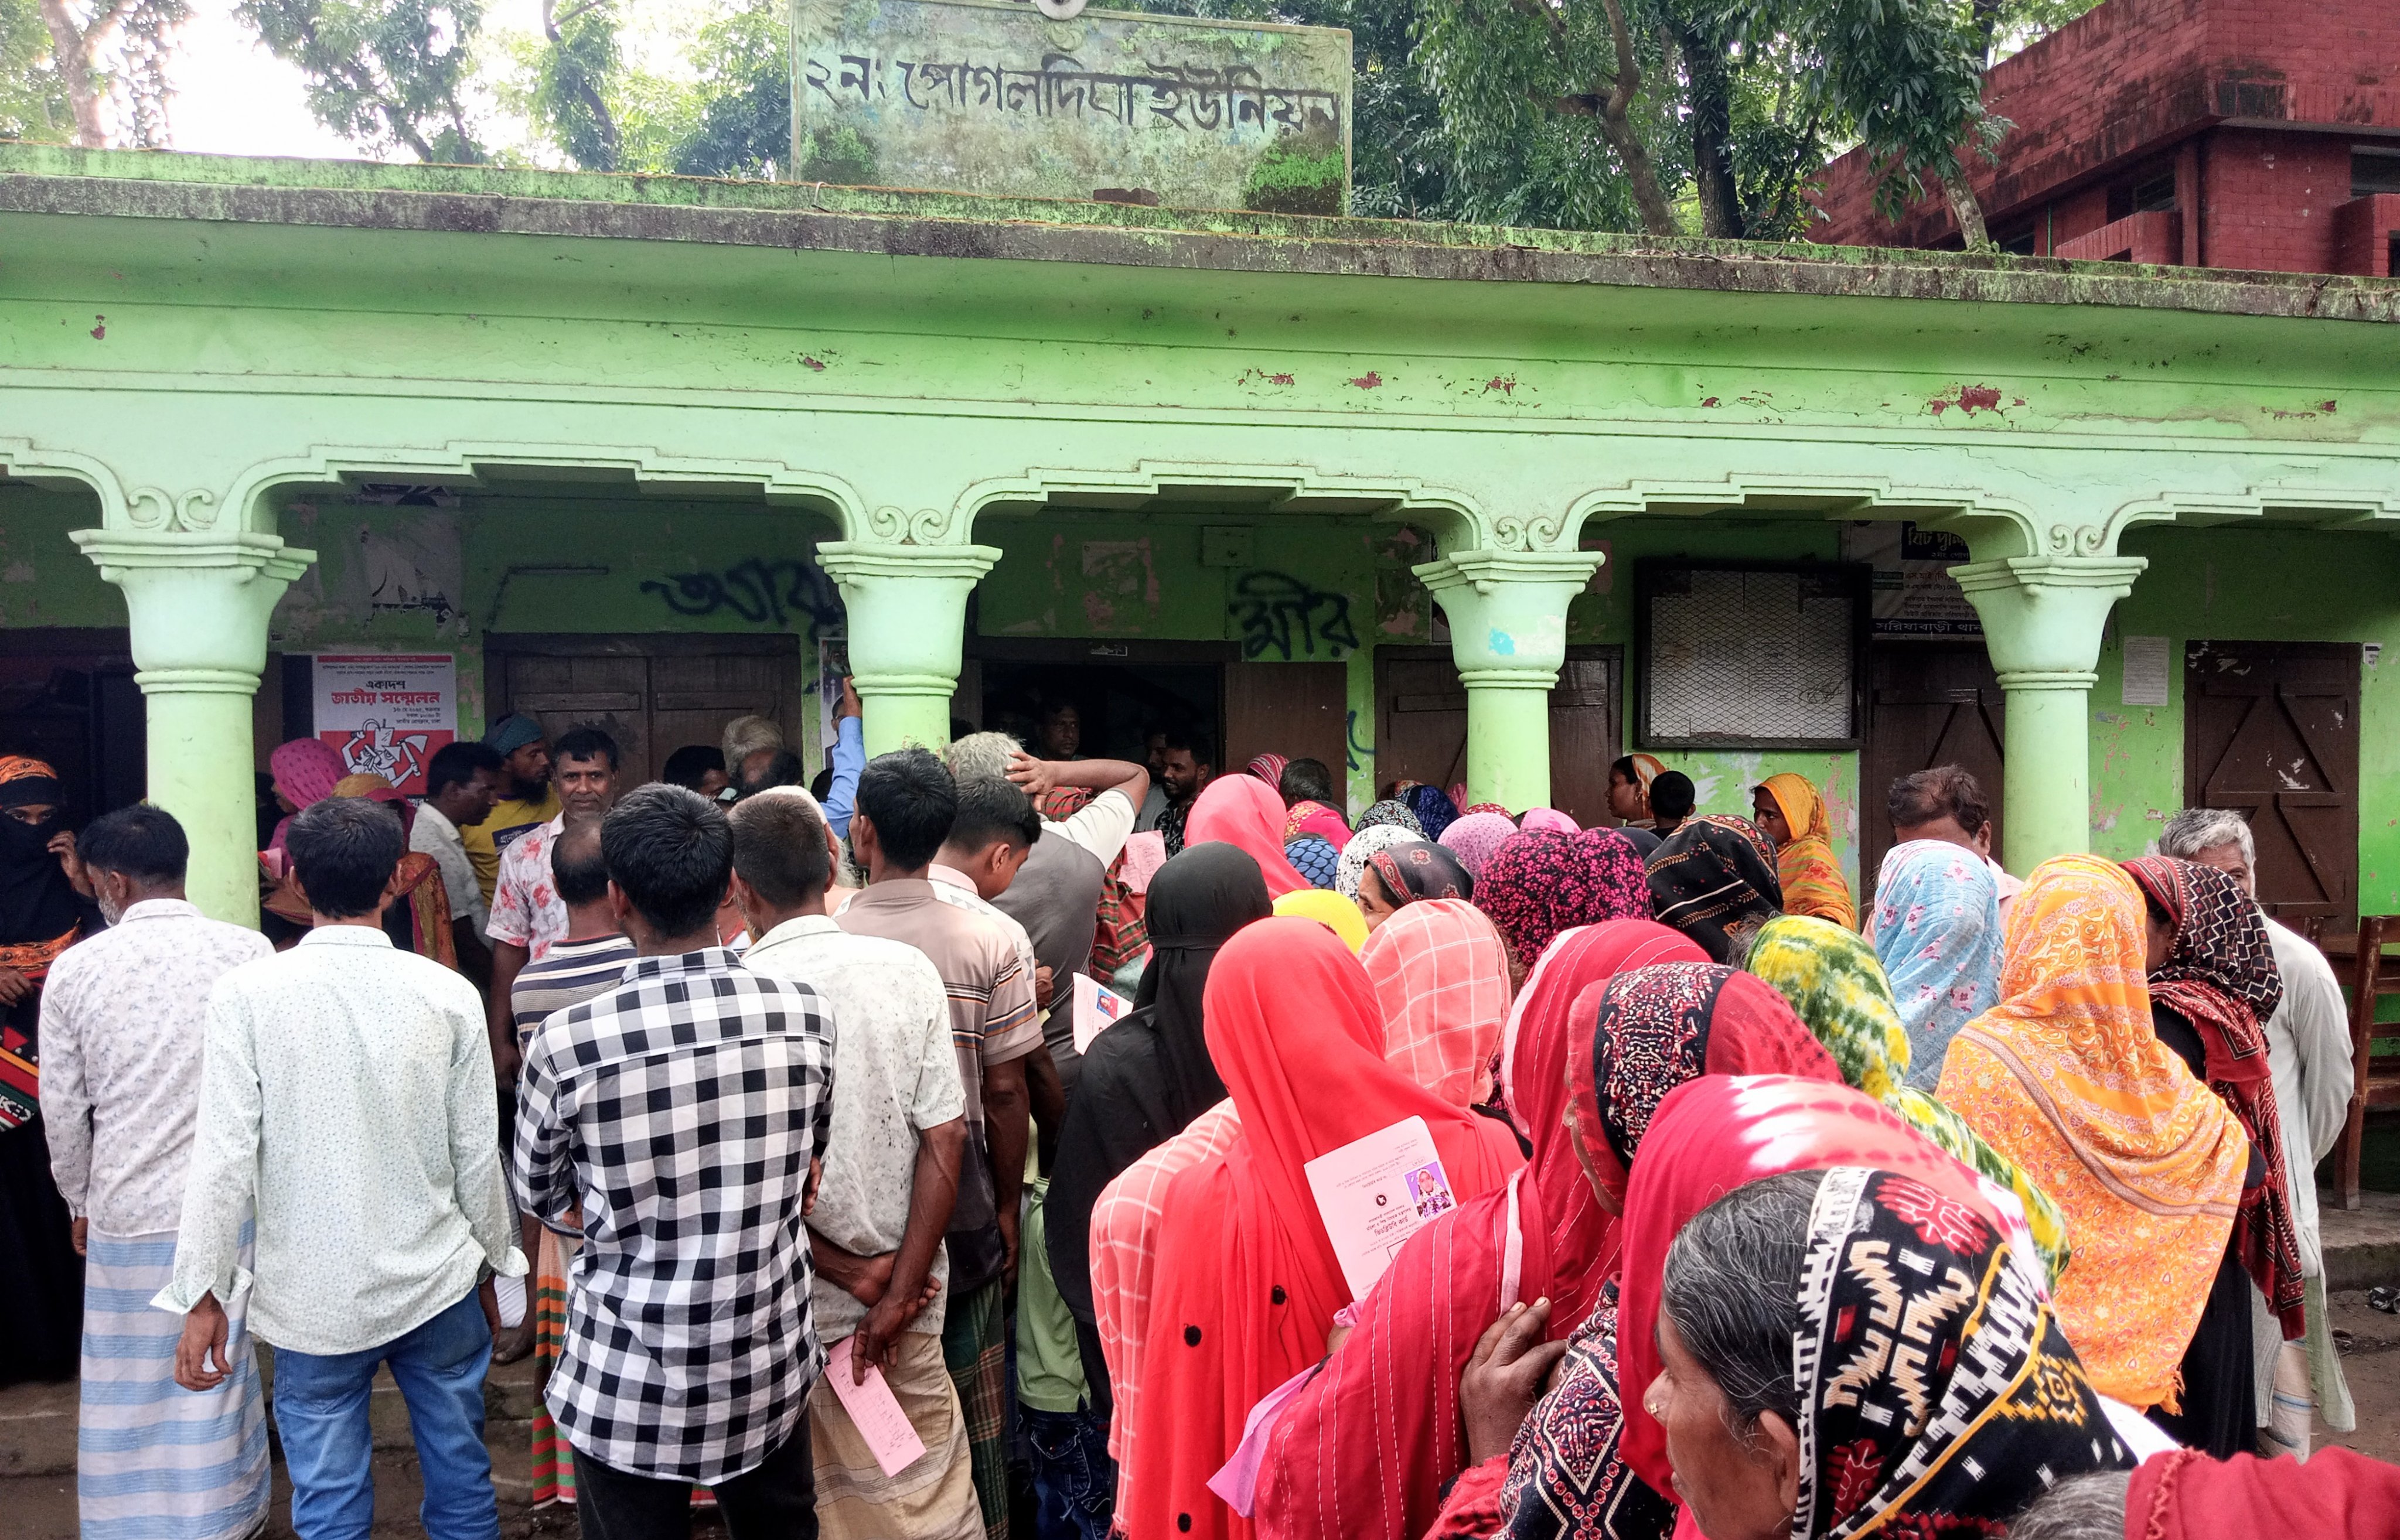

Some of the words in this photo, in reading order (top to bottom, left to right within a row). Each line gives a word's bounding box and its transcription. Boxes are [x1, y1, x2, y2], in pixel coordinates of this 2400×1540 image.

[1145, 61, 1340, 138] ইউনিয়ন
[1937, 531, 1968, 551] পুলি
[1876, 620, 1952, 633] সরিষাবাড়ী
[1957, 623, 1983, 633] থান
[366, 680, 405, 689] একাদশ
[331, 688, 377, 706] জাতীয়
[380, 692, 441, 706] সম্মেলন
